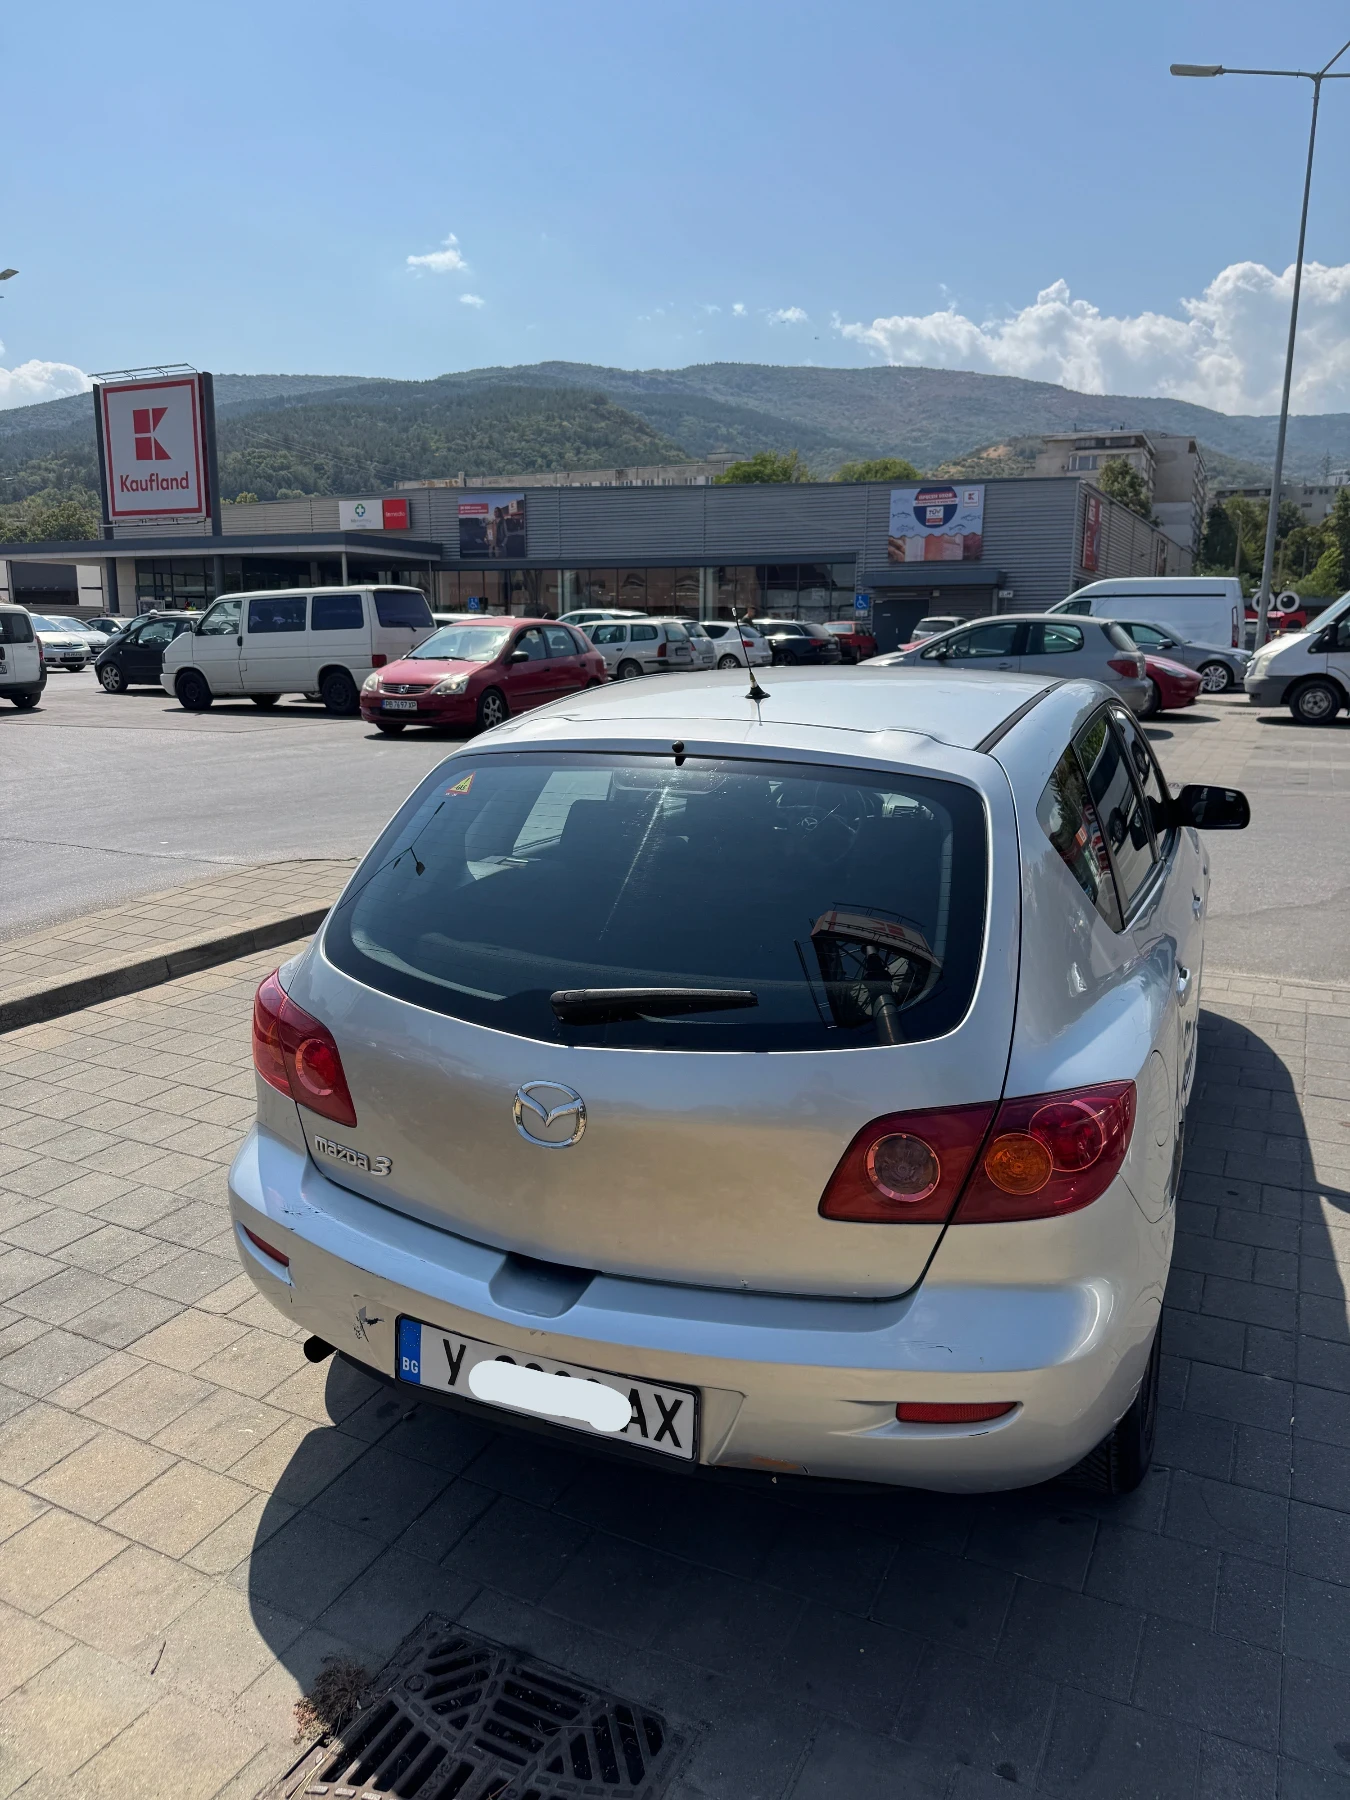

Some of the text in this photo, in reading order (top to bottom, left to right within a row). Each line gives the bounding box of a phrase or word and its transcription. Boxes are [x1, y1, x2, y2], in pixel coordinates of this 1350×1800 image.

[120, 470, 190, 493] Kaufland
[370, 1155, 394, 1177] 3
[402, 1356, 419, 1374] BG
